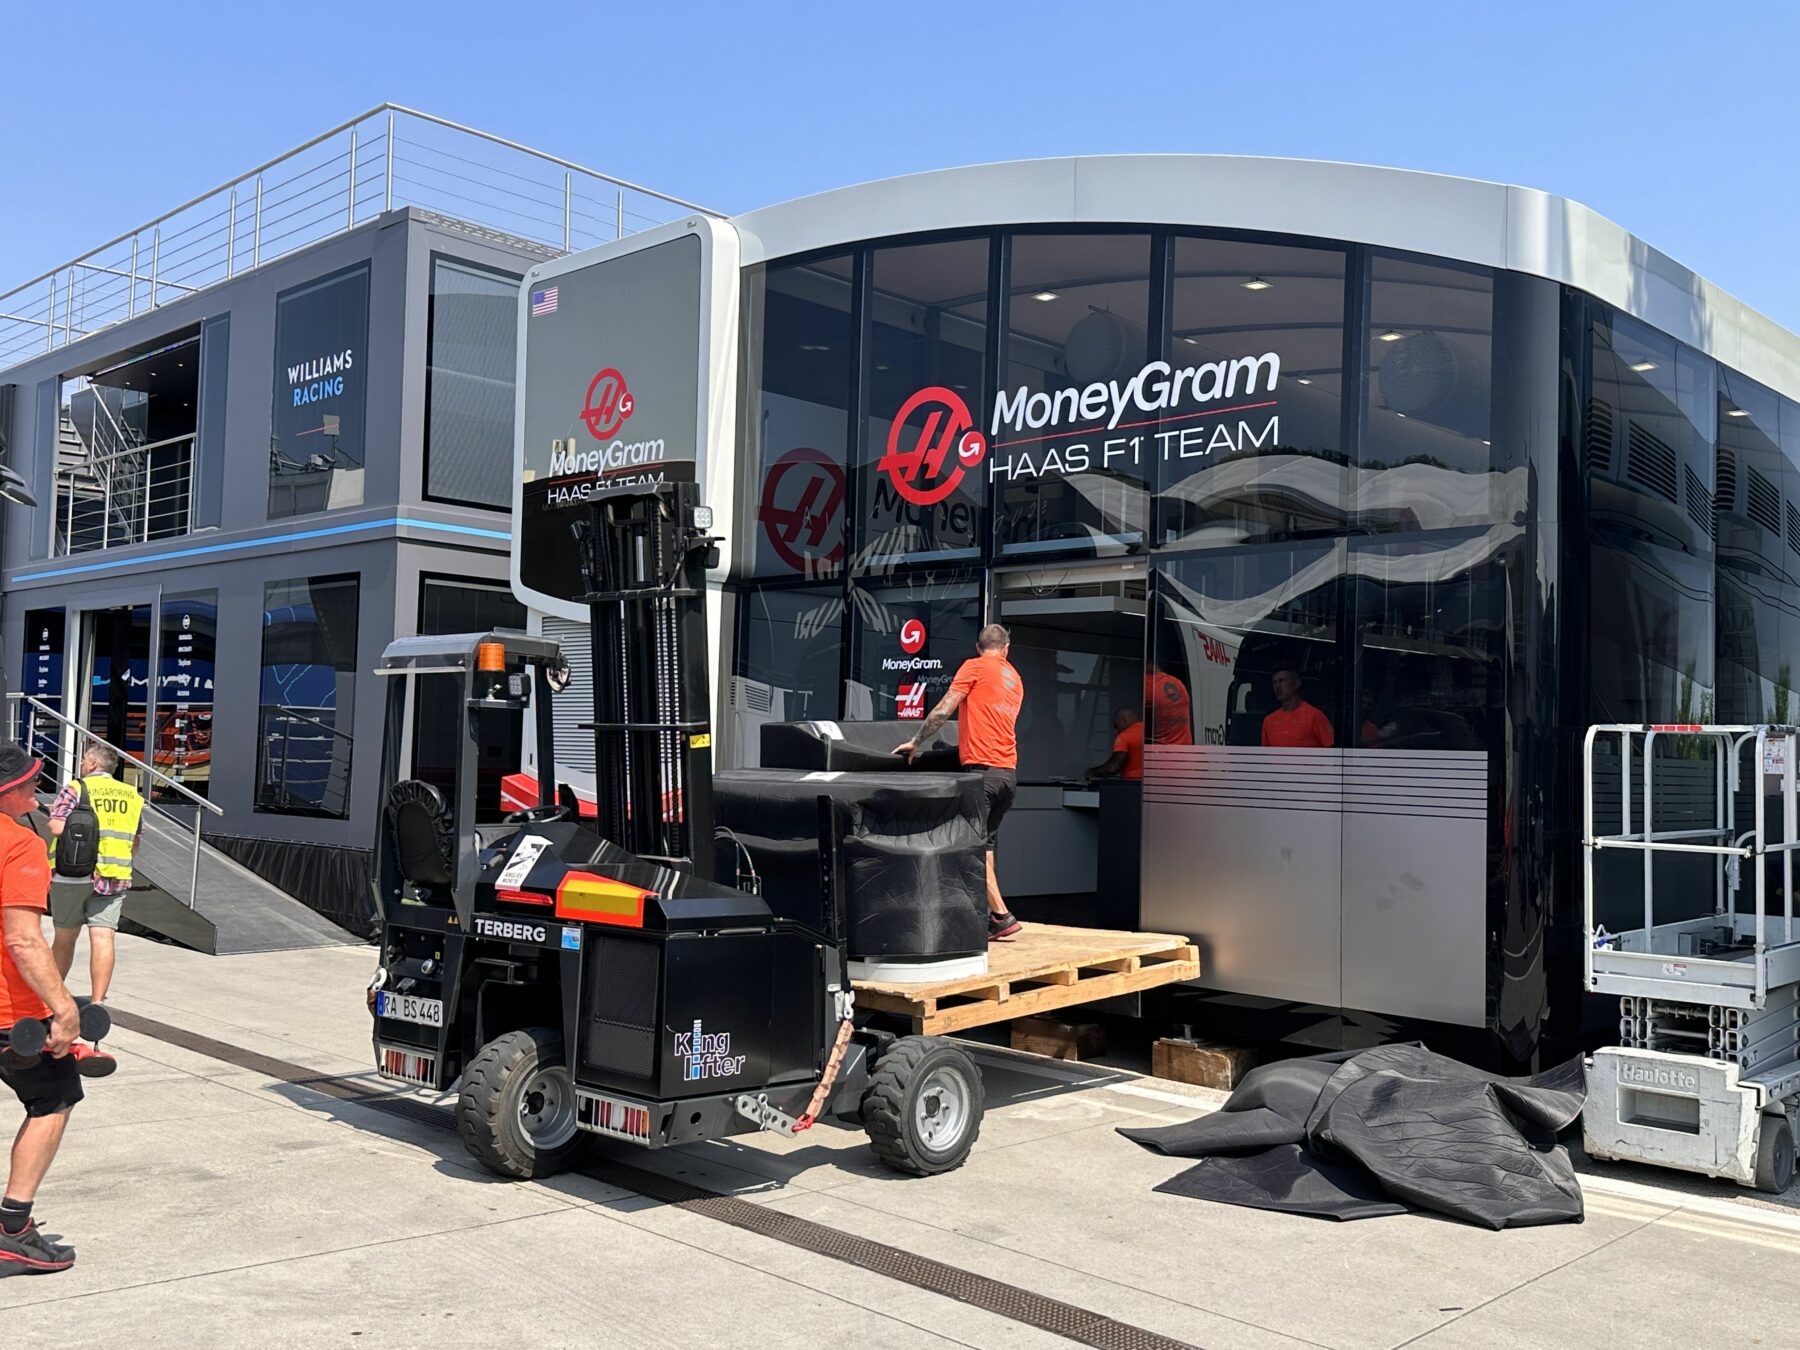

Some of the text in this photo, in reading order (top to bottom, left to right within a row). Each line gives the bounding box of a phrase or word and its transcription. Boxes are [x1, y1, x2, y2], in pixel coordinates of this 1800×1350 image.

[288, 349, 353, 385] WILLIAMS
[293, 376, 344, 407] RACING
[989, 352, 1281, 436] MoneyGram
[549, 438, 665, 478] MoneyGram
[988, 444, 1090, 484] HAAS
[1154, 416, 1280, 461] TEAM
[547, 483, 592, 505] HAAS
[94, 799, 128, 814] FOTO
[474, 919, 547, 942] TERBERG
[403, 999, 417, 1019] BS
[419, 1002, 440, 1023] 448
[1622, 1063, 1697, 1089] Haulotte
